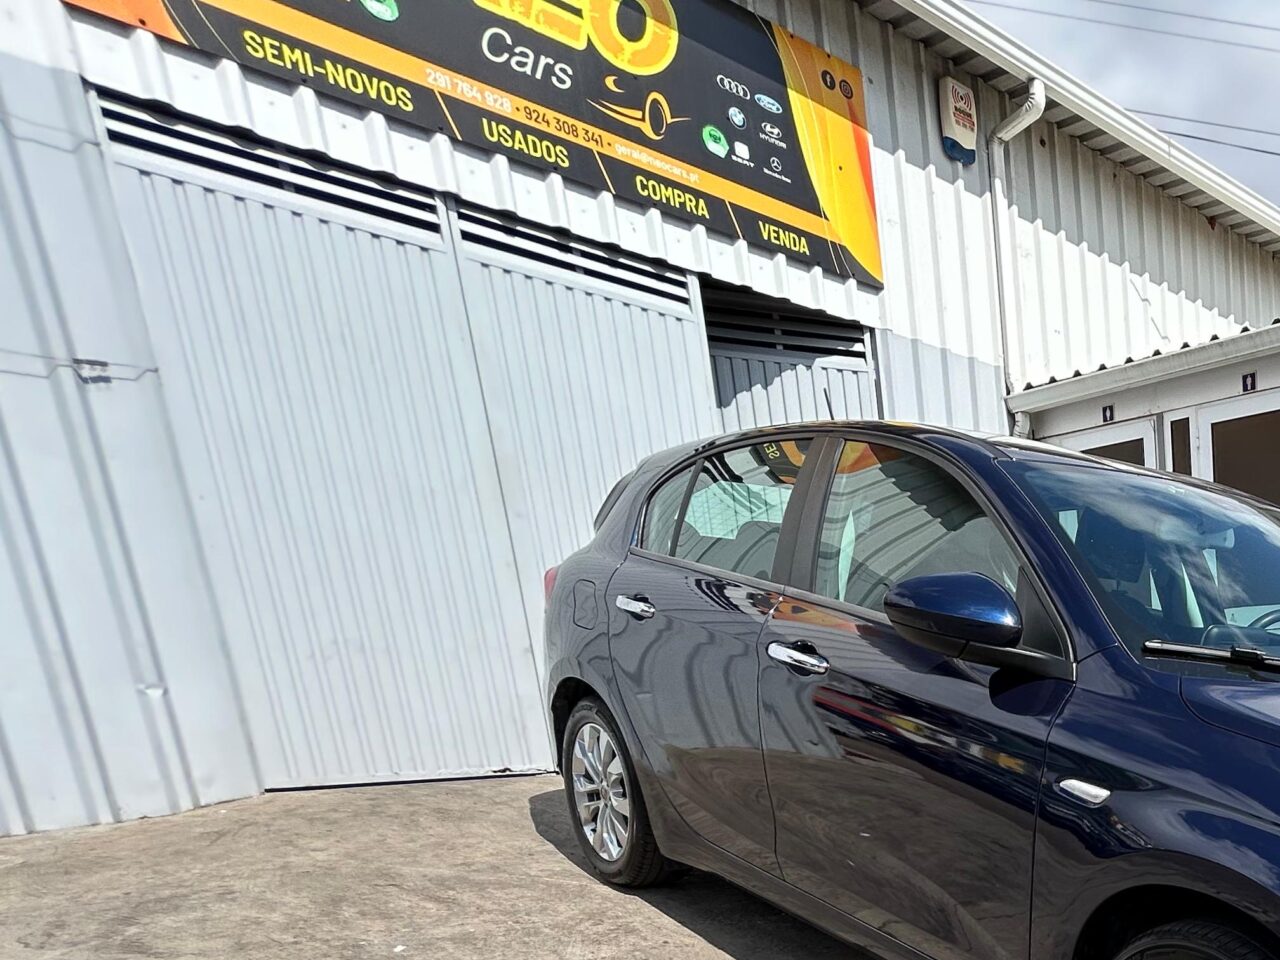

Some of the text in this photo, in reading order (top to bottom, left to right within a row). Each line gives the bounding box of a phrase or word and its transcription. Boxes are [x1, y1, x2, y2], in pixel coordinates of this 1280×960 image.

[242, 30, 414, 112] SEMI-NOVOS
[481, 27, 574, 90] Cars
[424, 68, 452, 90] 291
[456, 79, 482, 101] 764
[523, 105, 550, 127] 924
[553, 116, 579, 138] 308
[582, 127, 604, 148] 341
[481, 118, 570, 168] USADOS
[635, 175, 710, 219] COMPRA
[758, 220, 810, 256] VENDA
